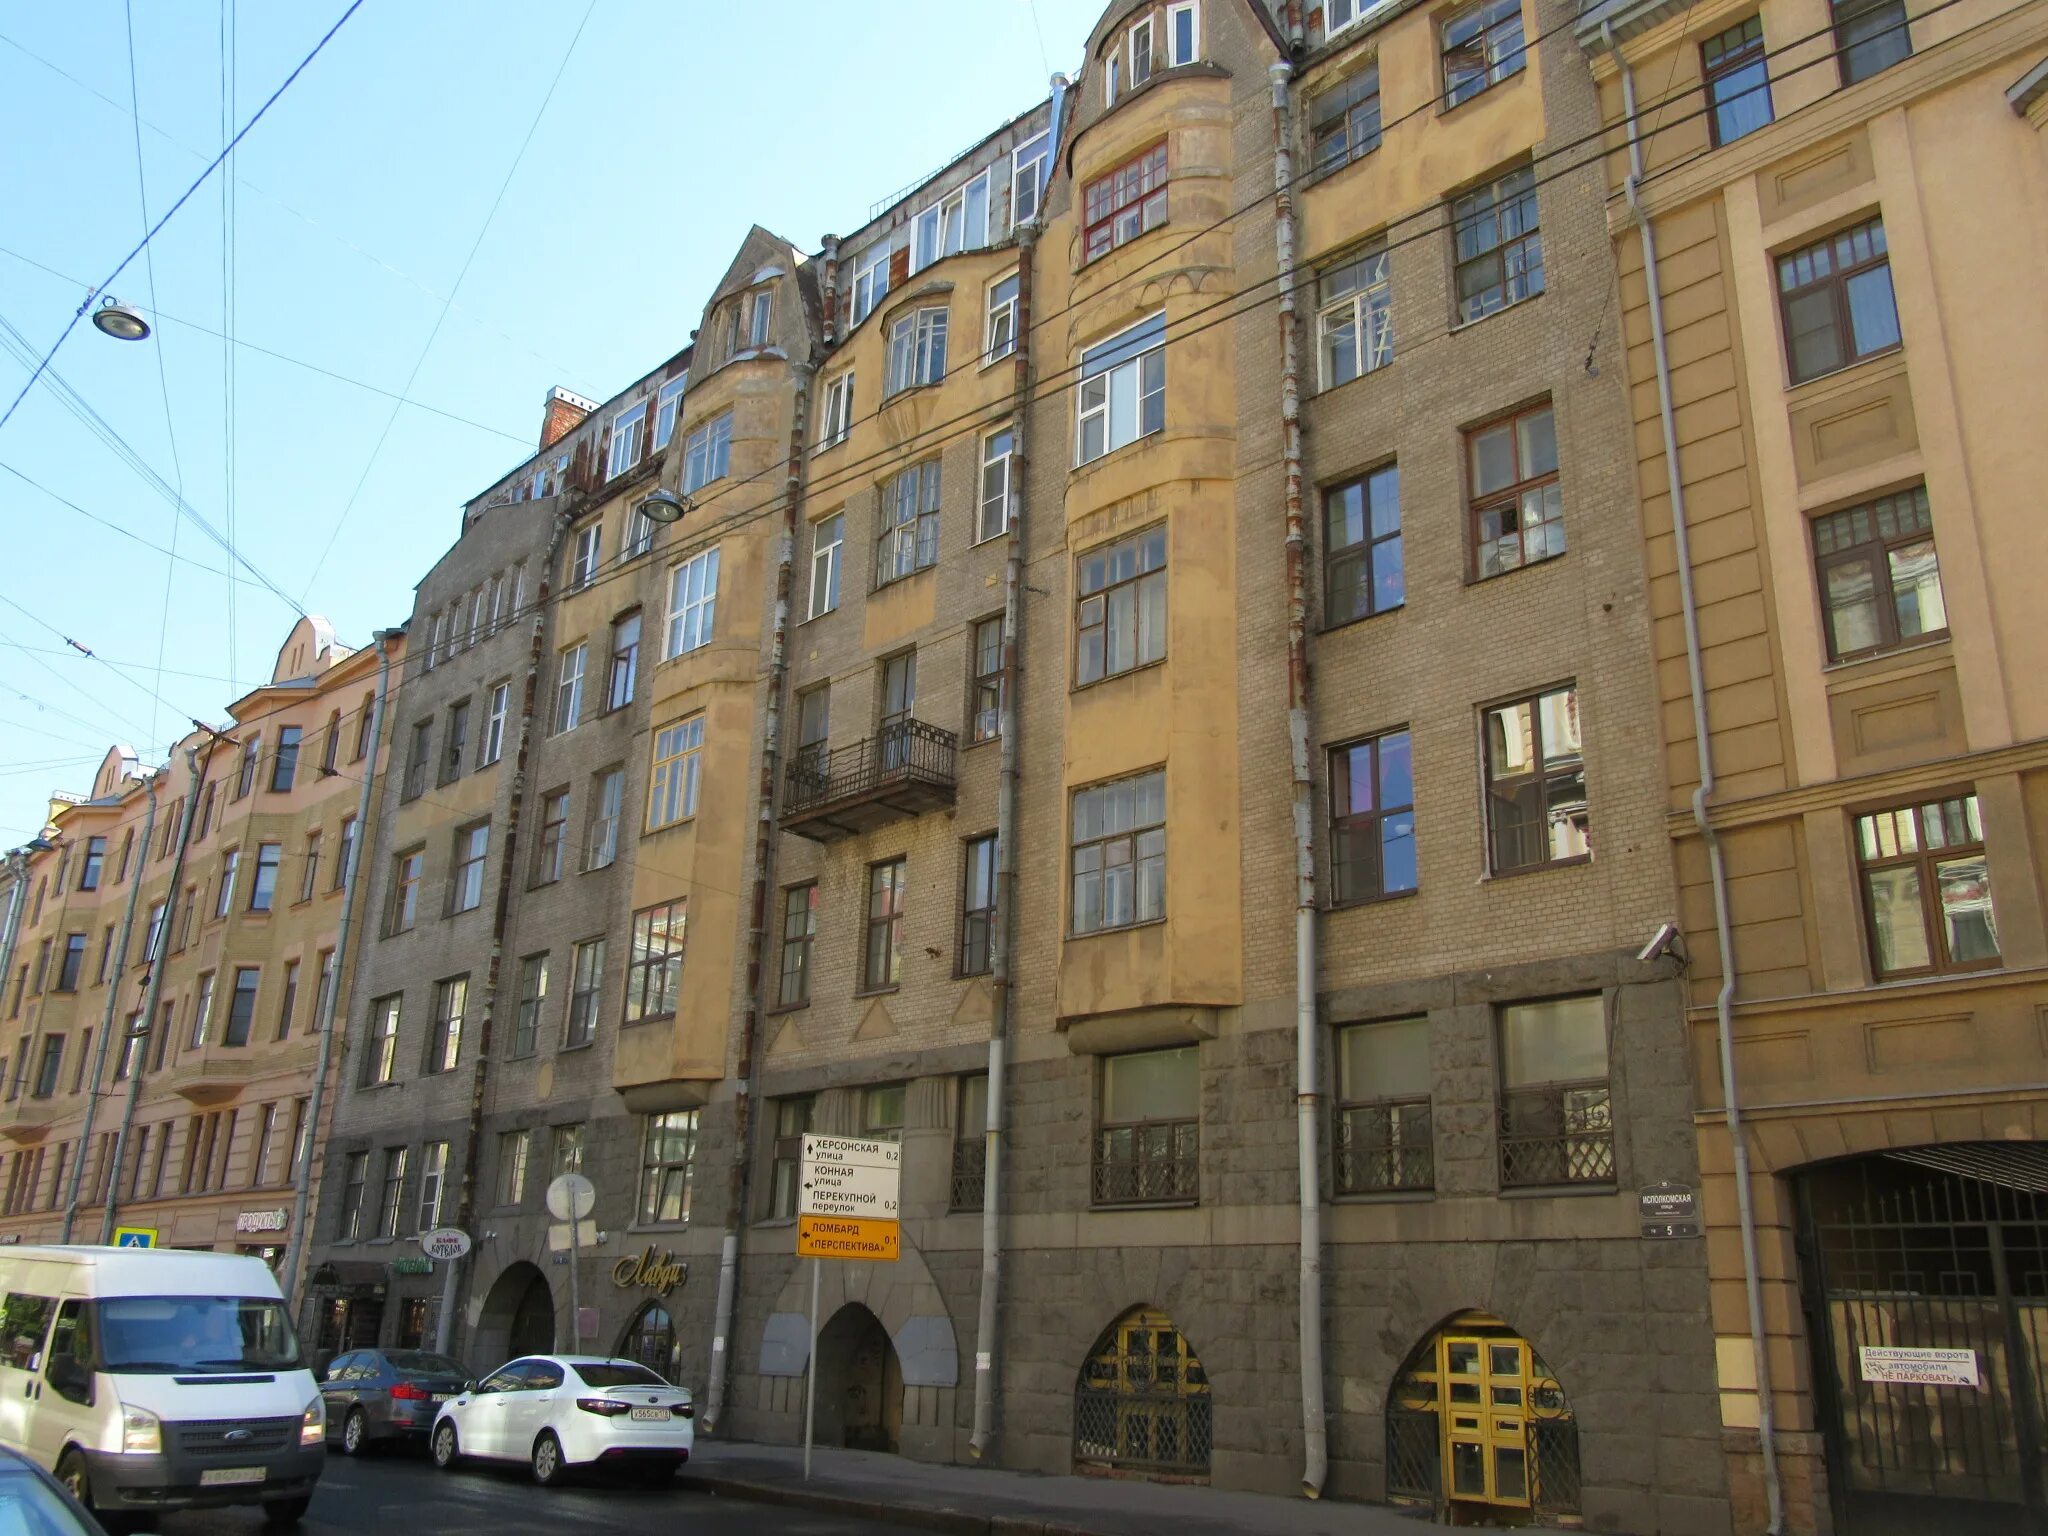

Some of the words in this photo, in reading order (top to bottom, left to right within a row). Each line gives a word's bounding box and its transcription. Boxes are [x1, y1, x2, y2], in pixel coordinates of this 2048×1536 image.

[816, 1140, 878, 1153] ХЕРСОНСКАЯ
[816, 1152, 843, 1160] улица
[886, 1152, 898, 1160] 0,2
[814, 1166, 854, 1176] КОННАЯ
[814, 1178, 842, 1186] улица
[813, 1191, 876, 1204] ПЕРЕКУПНОЙ
[1643, 1194, 1691, 1204] ИСПОЛКОМСКАЯ
[812, 1203, 855, 1212] переулок
[884, 1201, 896, 1210] 0,2
[812, 1223, 859, 1235] ЛОМБАРД
[1667, 1226, 1672, 1235] 5
[884, 1236, 897, 1245] 0,1
[810, 1240, 884, 1252] «ПЕРСПЕКТИВА»
[1866, 1348, 1932, 1359] Действующие
[1889, 1363, 1948, 1371] автомобили
[1897, 1373, 1957, 1382] ПАРКОВАТЬ!
